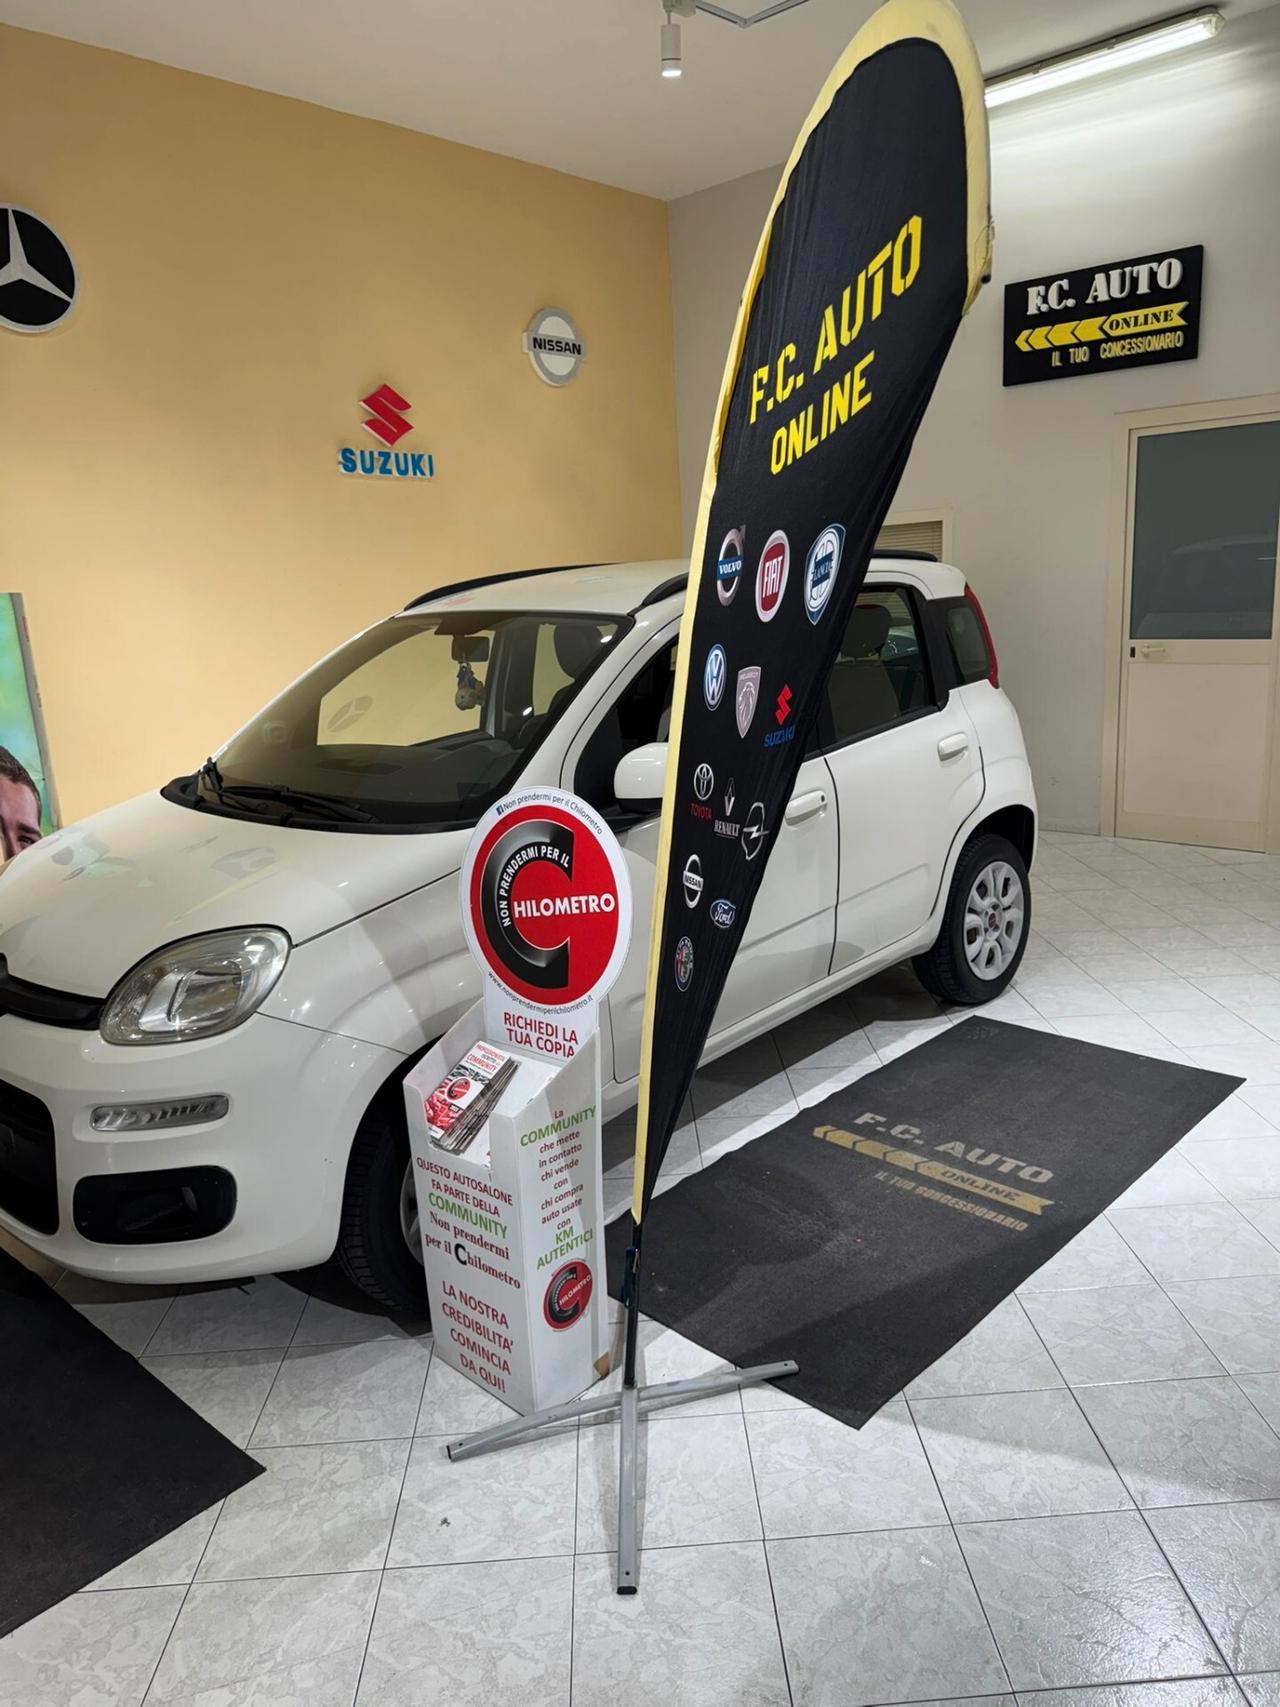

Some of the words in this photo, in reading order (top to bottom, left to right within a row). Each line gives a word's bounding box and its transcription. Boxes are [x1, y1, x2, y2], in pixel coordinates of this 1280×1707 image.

[1026, 278, 1076, 315] F.C.
[1085, 257, 1183, 304] AUTO
[750, 342, 804, 425] F.C.
[813, 214, 922, 376] AUTO
[1109, 309, 1174, 332] ONLINE
[532, 336, 582, 356] NISSAN
[1051, 350, 1062, 367] IL
[1069, 346, 1090, 364] TUO
[1100, 331, 1183, 359] CONCESSIONARIO
[770, 349, 875, 476] ONLINE
[341, 447, 434, 477] SUZUKI
[719, 560, 742, 575] VOLVO
[762, 555, 783, 598] FIAT
[764, 725, 796, 748] SUZUKI
[503, 798, 517, 811] Non
[517, 792, 551, 805] prendermi
[552, 795, 565, 804] per
[564, 799, 570, 807] il
[570, 801, 603, 835] Chilometro
[690, 803, 712, 819] TOYOTA
[714, 820, 740, 837] RENAULT
[540, 845, 560, 860] PER
[561, 853, 570, 868] IL
[499, 846, 538, 896] PRENDERMI
[684, 873, 702, 888] NISSAN
[499, 900, 512, 927] NON
[714, 902, 733, 924] Ford
[503, 1012, 558, 1039] RICHIEDI
[562, 1027, 579, 1045] LA
[506, 1028, 532, 1047] TUA
[536, 1036, 575, 1058] COPIA
[520, 1105, 596, 1147] COMMUNITY
[554, 1110, 564, 1119] La
[538, 1160, 547, 1168] in
[549, 1143, 582, 1164] contatto
[539, 1142, 554, 1153] che
[556, 1130, 580, 1147] mette
[853, 1111, 924, 1145] F.C.
[933, 1140, 1054, 1183] AUTO
[416, 1157, 451, 1179] QUESTO
[453, 1172, 513, 1206] AUTOSALONE
[541, 1169, 553, 1181] chi
[555, 1158, 579, 1175] vende
[554, 1178, 568, 1189] con
[431, 1179, 442, 1193] FA
[444, 1184, 470, 1204] PARTE
[472, 1196, 500, 1217] DELLA
[541, 1197, 553, 1210] chi
[555, 1183, 584, 1204] compra
[941, 1169, 1022, 1202] ONLINE
[428, 1192, 508, 1239] COMMUNITY
[542, 1209, 560, 1224] auto
[562, 1198, 582, 1214] usate
[874, 1170, 886, 1181] IL
[887, 1175, 916, 1190] TUO
[914, 1185, 1029, 1232] CONCESSIONARIO
[429, 1211, 450, 1231] Non
[453, 1225, 510, 1260] prendermi
[555, 1226, 574, 1245] KM
[557, 1217, 571, 1230] con
[425, 1233, 442, 1247] per
[444, 1240, 452, 1255] il
[454, 1243, 521, 1289] Chilometro
[537, 1228, 593, 1270] AUTENTICI
[442, 1280, 457, 1300] LA
[459, 1290, 509, 1329] NOSTRA
[442, 1302, 513, 1354] CREDIBILITA'
[450, 1328, 511, 1376] COMINCIA
[460, 1353, 477, 1375] DA
